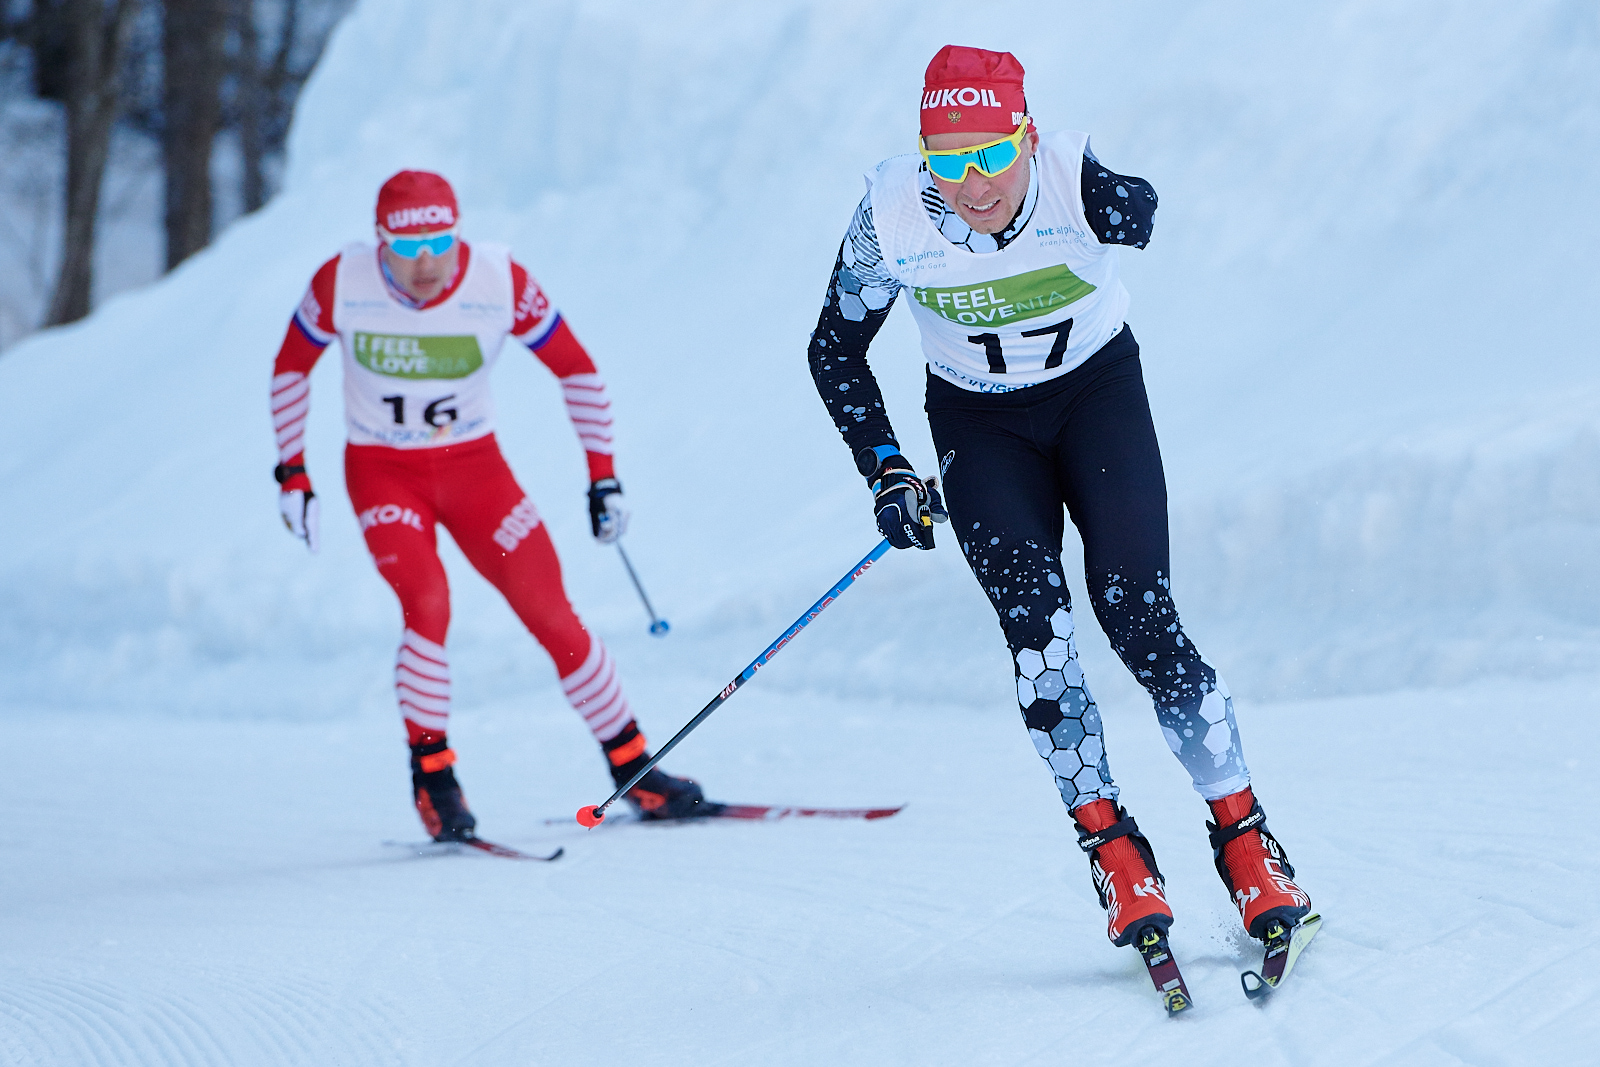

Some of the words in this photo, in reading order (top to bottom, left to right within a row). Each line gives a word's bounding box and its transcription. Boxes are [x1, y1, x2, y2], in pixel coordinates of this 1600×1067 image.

[921, 87, 1002, 110] LUKOIL
[387, 205, 455, 230] LUKOIL
[1035, 227, 1055, 238] hit
[908, 249, 946, 263] alpinea
[936, 287, 1006, 310] FEEL
[371, 337, 426, 357] FEEL
[967, 317, 1074, 375] 17
[382, 394, 458, 428] 16
[359, 504, 425, 531] KOIL
